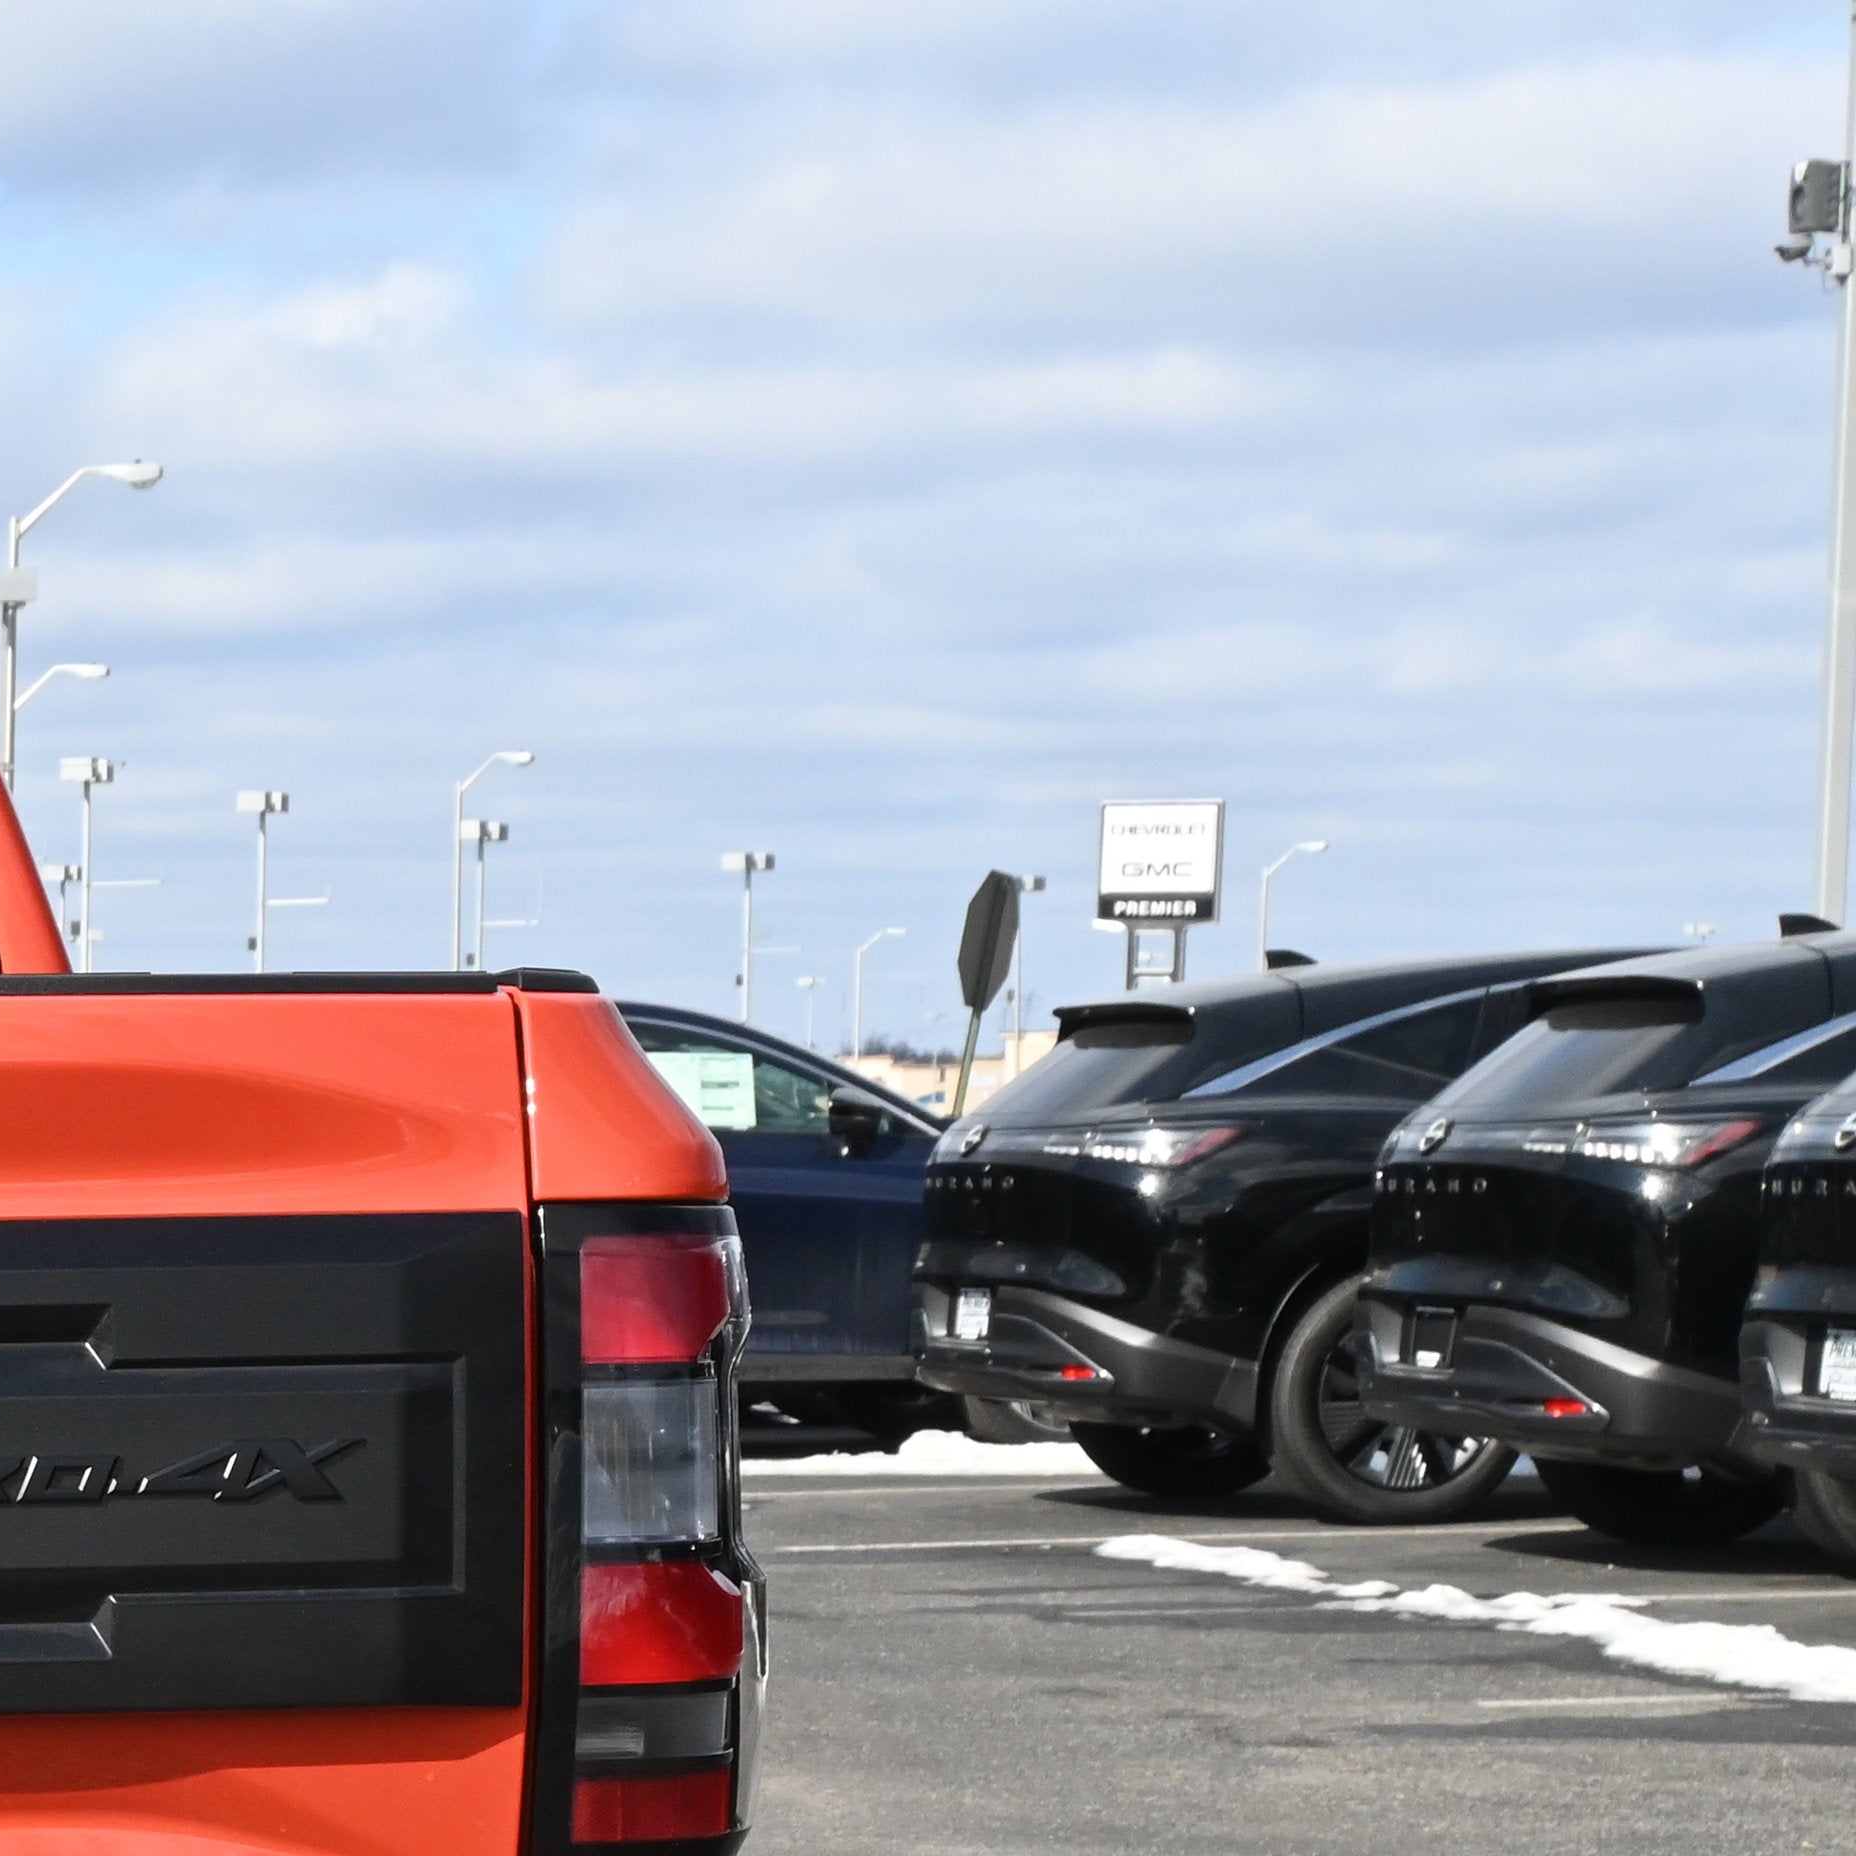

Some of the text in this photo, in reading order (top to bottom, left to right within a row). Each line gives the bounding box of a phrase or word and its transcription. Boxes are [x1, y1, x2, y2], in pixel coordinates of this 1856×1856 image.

[1111, 823, 1206, 836] CHEVROLET
[1122, 862, 1193, 877] GMC
[1114, 900, 1197, 916] PREMIER
